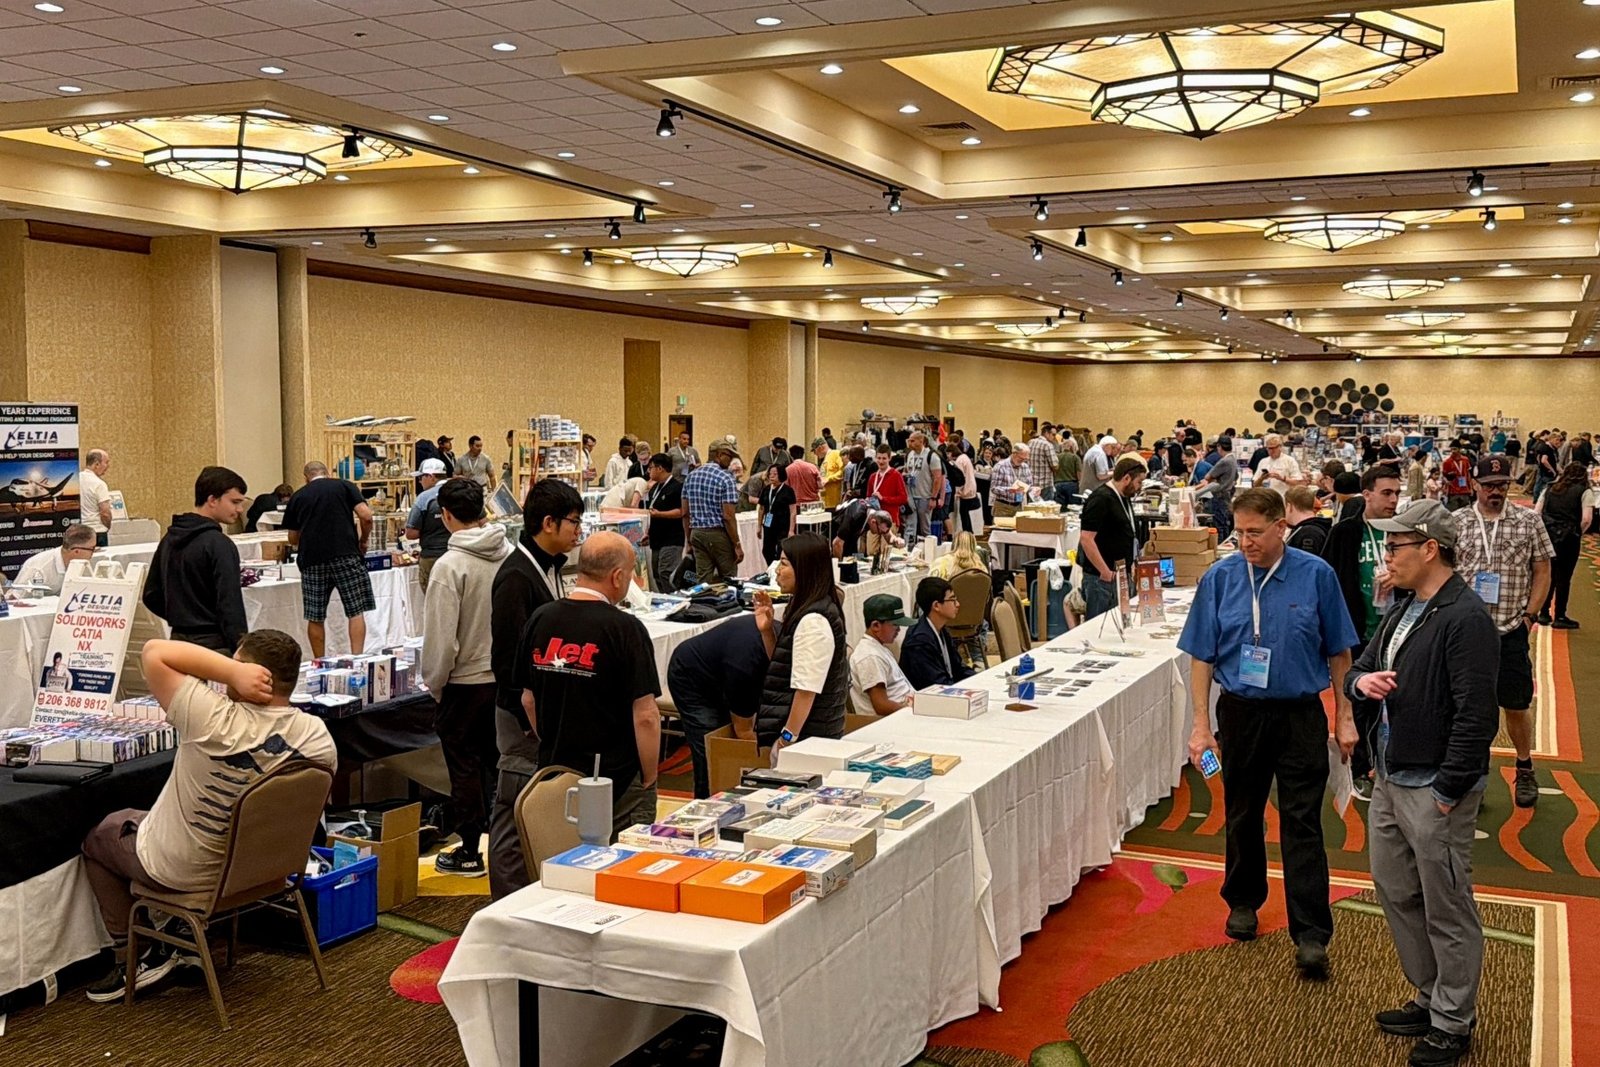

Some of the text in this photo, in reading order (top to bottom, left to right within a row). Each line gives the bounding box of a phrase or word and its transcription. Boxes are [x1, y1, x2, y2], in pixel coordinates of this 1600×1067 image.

[1, 407, 71, 415] YEARS EXPERIENCE
[5, 430, 58, 446] KELTIA
[65, 590, 123, 610] KELTIA
[55, 614, 126, 629] SOLIDWORKS
[72, 627, 103, 640] CATIA
[77, 640, 93, 651] NX
[532, 637, 599, 666] Jet
[45, 694, 108, 711] 206 368 9812
[34, 714, 64, 723] EVERETT
